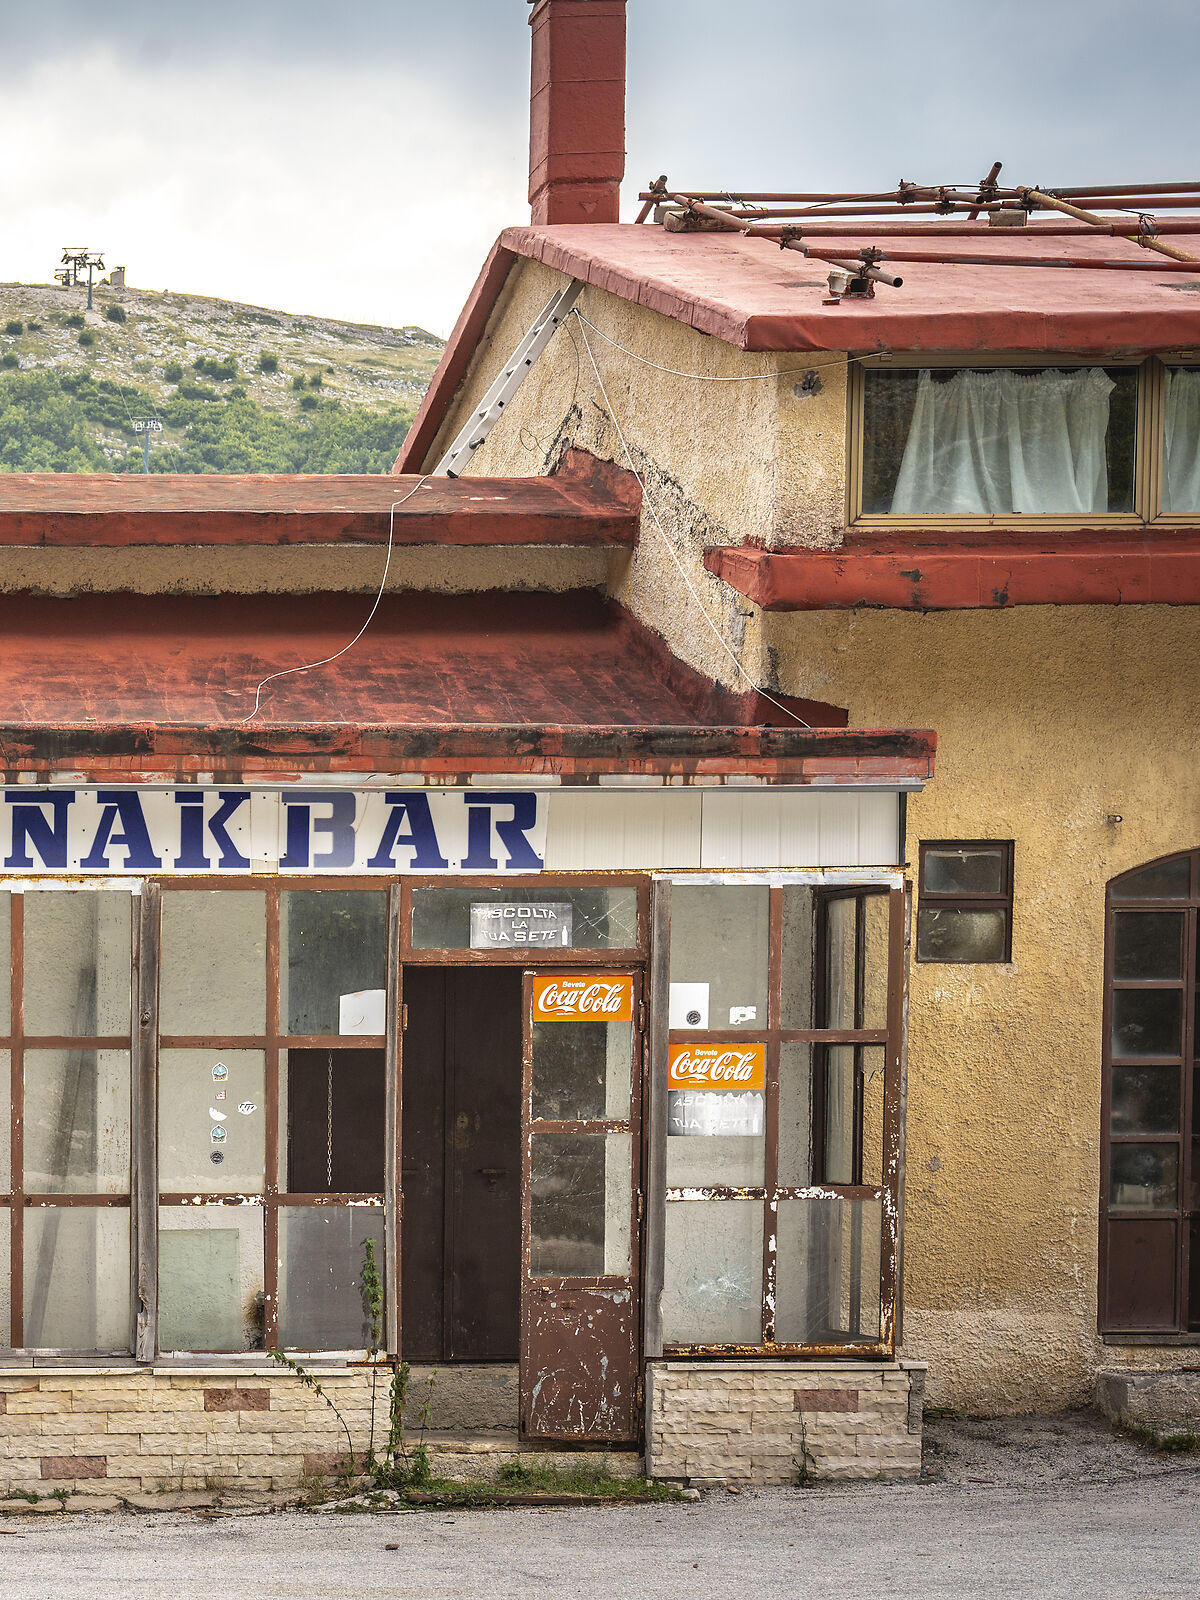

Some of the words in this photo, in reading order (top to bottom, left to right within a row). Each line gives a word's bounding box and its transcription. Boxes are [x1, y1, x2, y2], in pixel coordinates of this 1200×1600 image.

[279, 792, 544, 869] BAR
[482, 907, 557, 919] ASCOLTA
[511, 920, 528, 929] LA
[481, 930, 511, 942] TUA
[513, 929, 558, 942] SETE
[538, 983, 625, 1013] Coca-Cola
[670, 1051, 757, 1081] Coca-Cola
[672, 1117, 702, 1129] TUA
